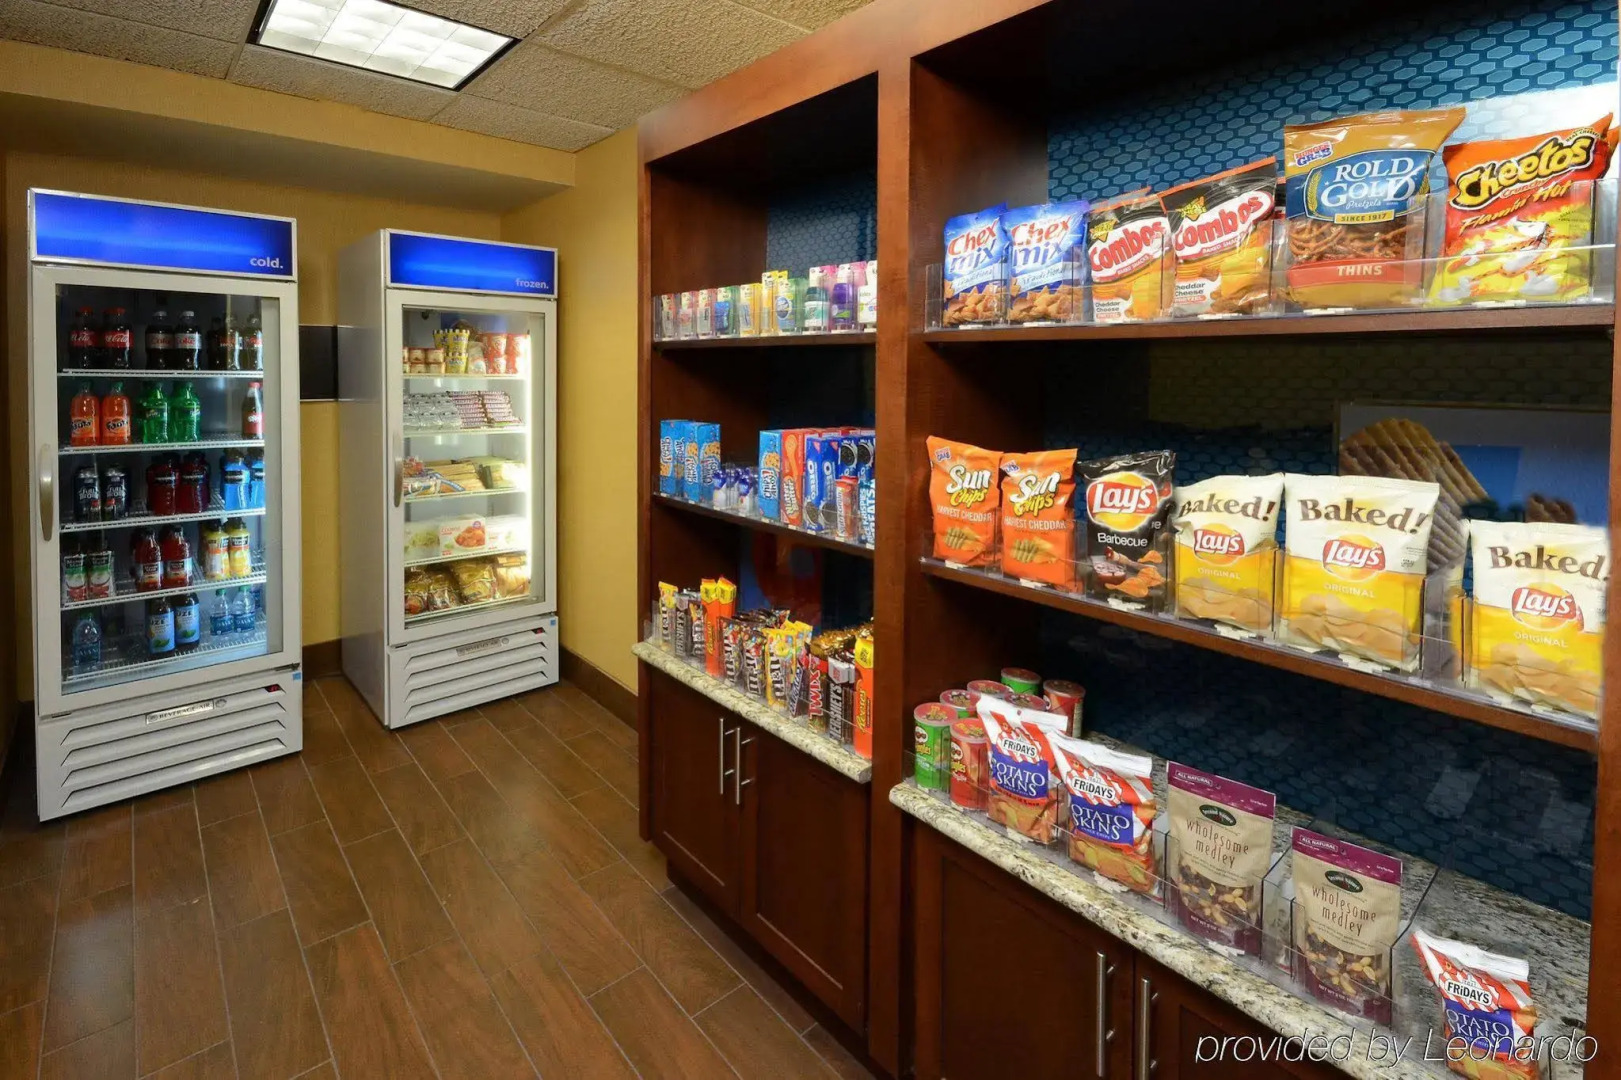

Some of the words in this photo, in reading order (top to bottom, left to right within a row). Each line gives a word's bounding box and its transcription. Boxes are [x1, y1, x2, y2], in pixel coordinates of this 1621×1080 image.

[1333, 157, 1414, 183] ROLD
[1452, 136, 1593, 208] Cheetos
[1320, 176, 1416, 208] GOLD
[1501, 178, 1550, 199] Crunchy
[1532, 180, 1574, 203] Hot
[1341, 214, 1366, 222] SINCE
[1345, 199, 1382, 210] Pretzels
[947, 216, 1000, 256] Chex
[1011, 212, 1073, 247] Chex
[1174, 196, 1264, 251] Combos
[949, 237, 997, 273] mix
[1012, 239, 1063, 268] mix
[1089, 220, 1166, 273] Combos
[250, 256, 284, 269] cold.
[1337, 264, 1383, 277] THINS
[515, 277, 549, 290] frozen.
[946, 464, 992, 494] Sun
[1009, 471, 1061, 504] Sun
[949, 488, 988, 509] Chips
[1178, 493, 1277, 522] Baked!
[960, 510, 993, 522] CHEDDAR
[1028, 519, 1067, 531] CHEDDAR
[1297, 497, 1431, 534] Baked!
[1097, 532, 1149, 547] Barbecue
[1197, 566, 1242, 580] ORIGINAL
[1487, 544, 1610, 582] Baked
[1323, 582, 1376, 599] ORIGINAL
[1513, 630, 1569, 649] ORIGINAL
[809, 668, 824, 720] TWIX
[993, 758, 1046, 787] OTATO
[996, 771, 1037, 797] SKINS
[1187, 775, 1211, 785] NATURAL
[1072, 812, 1121, 841] SKINS
[1186, 819, 1250, 855] wholesome
[1195, 839, 1236, 870] medley
[1312, 840, 1336, 850] NATURAL
[1312, 885, 1377, 922] wholesome
[1321, 905, 1364, 938] medley
